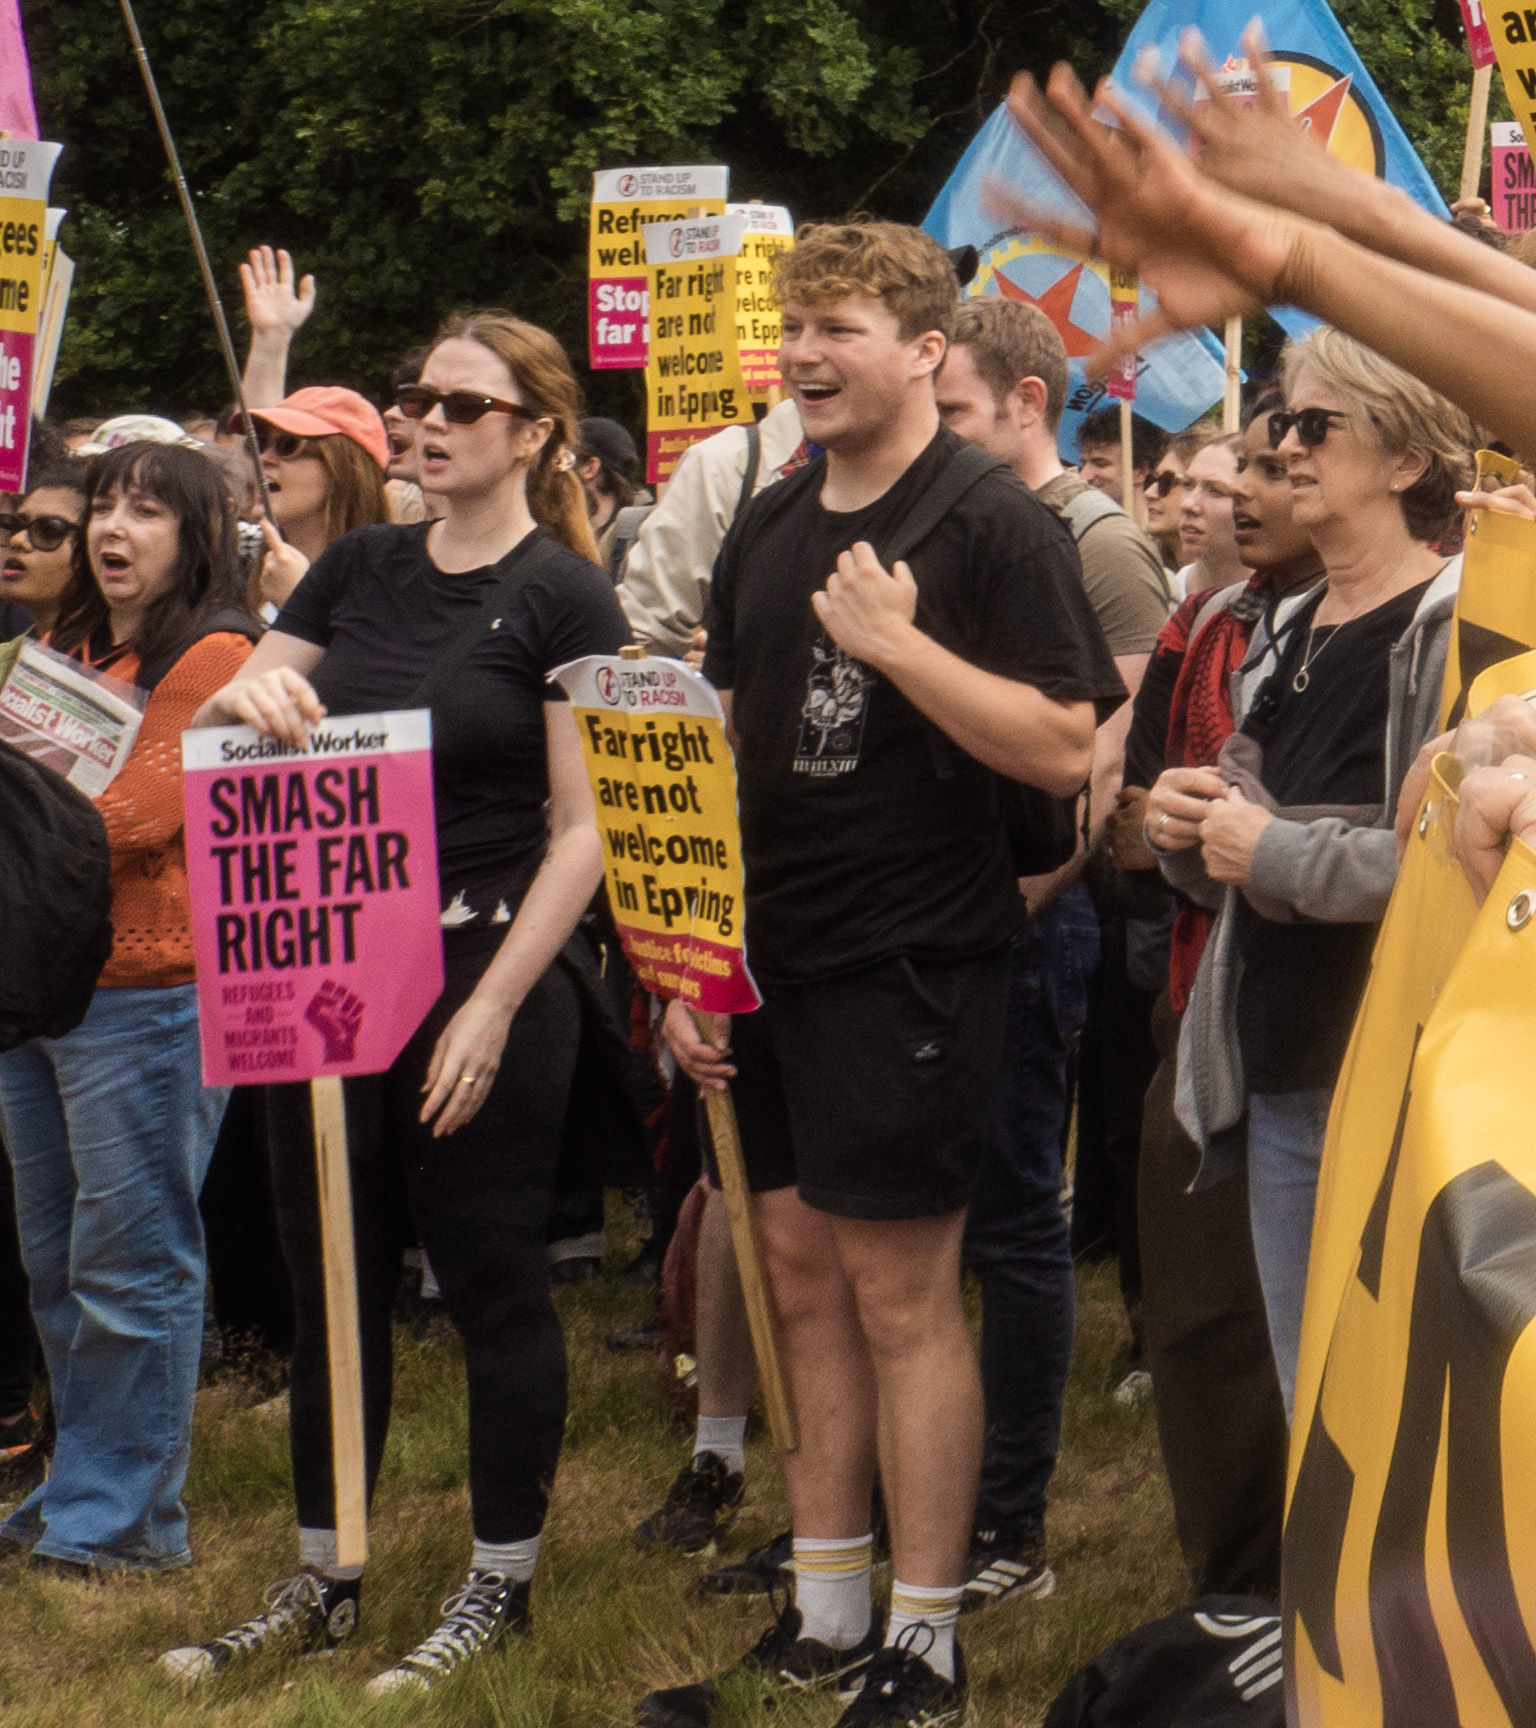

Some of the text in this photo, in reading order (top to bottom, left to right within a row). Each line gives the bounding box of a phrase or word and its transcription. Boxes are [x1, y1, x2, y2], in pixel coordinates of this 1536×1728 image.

[640, 172, 692, 185] STAND UP
[641, 183, 697, 196] TO RACISM
[656, 264, 724, 302] Far right
[597, 321, 636, 346] far
[657, 314, 683, 339] are
[753, 319, 783, 346] Epp
[657, 345, 723, 378] welcome
[657, 380, 739, 423] in Epping
[640, 689, 688, 708] RACISM
[54, 711, 118, 762] Worker
[309, 728, 389, 753] Worker
[585, 714, 714, 772] Far right
[210, 764, 380, 839] SMASH
[598, 775, 703, 815] are not
[606, 823, 728, 871] welcome
[210, 831, 411, 906] THE FAR
[613, 868, 735, 937] in Epping
[216, 903, 362, 974] RIGHT
[222, 981, 295, 1006] REFUGEES
[224, 1025, 298, 1048] MIGRANTS
[228, 1048, 297, 1071] WELCOME
